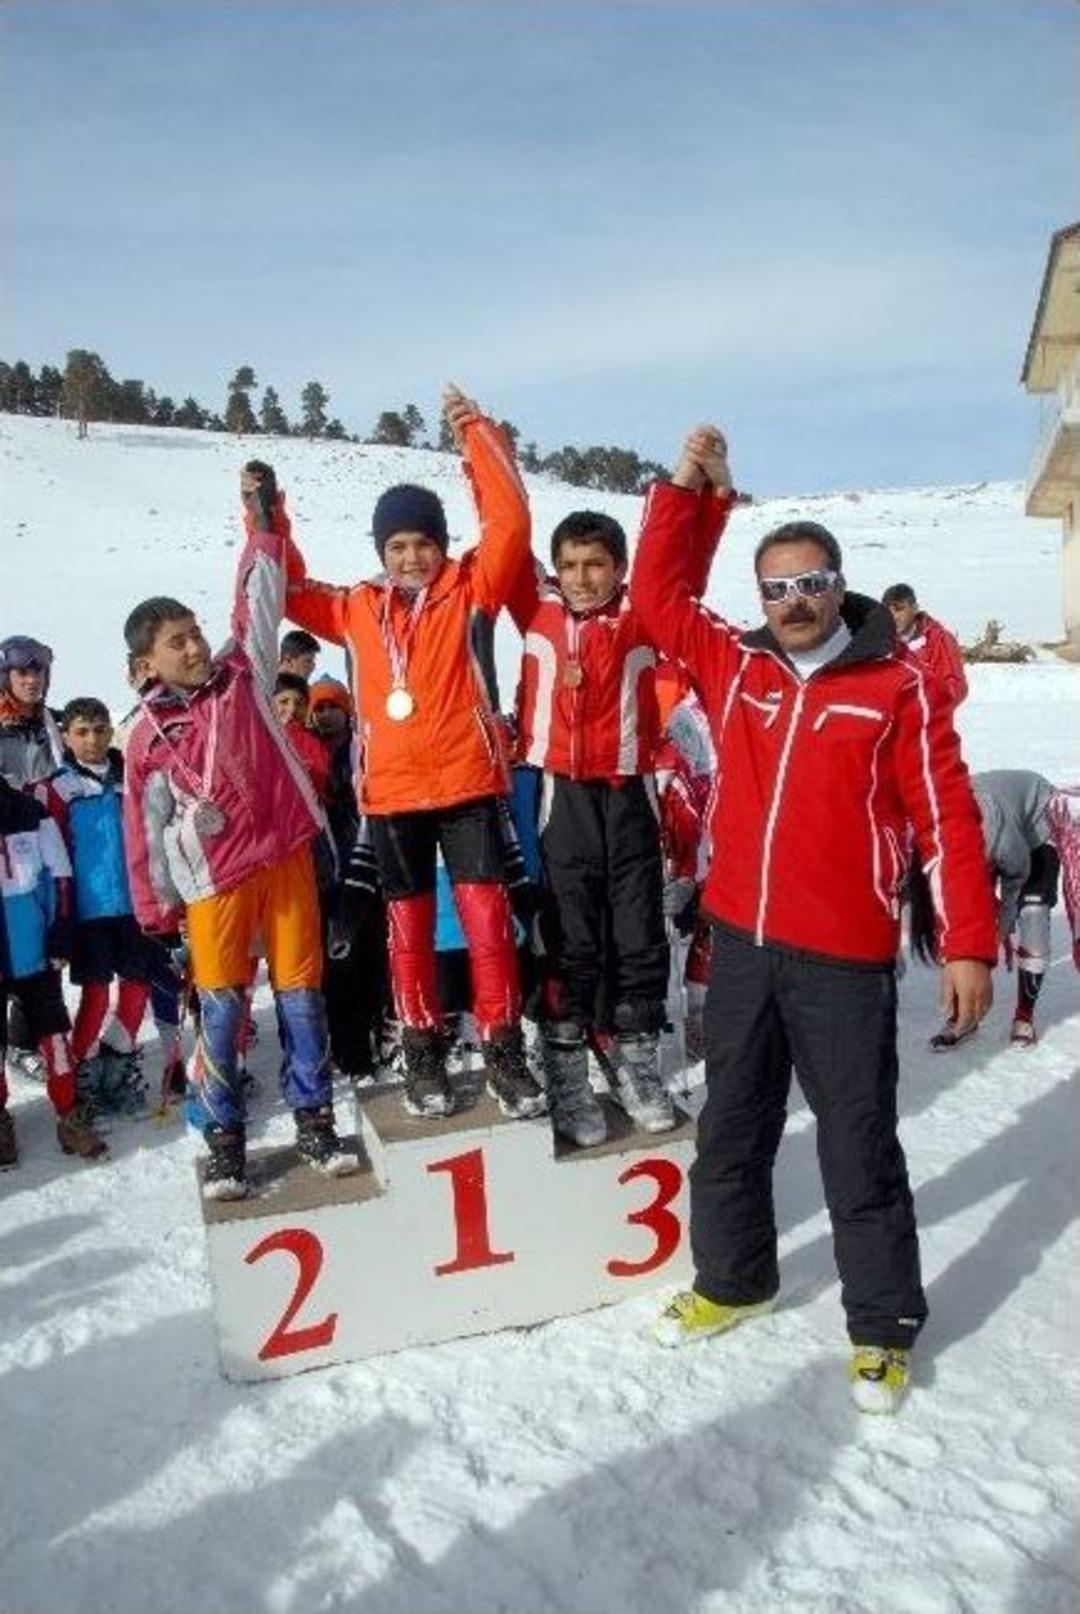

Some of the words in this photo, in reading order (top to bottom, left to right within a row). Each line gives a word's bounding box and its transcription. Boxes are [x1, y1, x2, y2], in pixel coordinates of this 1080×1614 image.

[427, 1148, 515, 1276] 1
[606, 1157, 684, 1277] 3
[244, 1227, 338, 1361] 2
